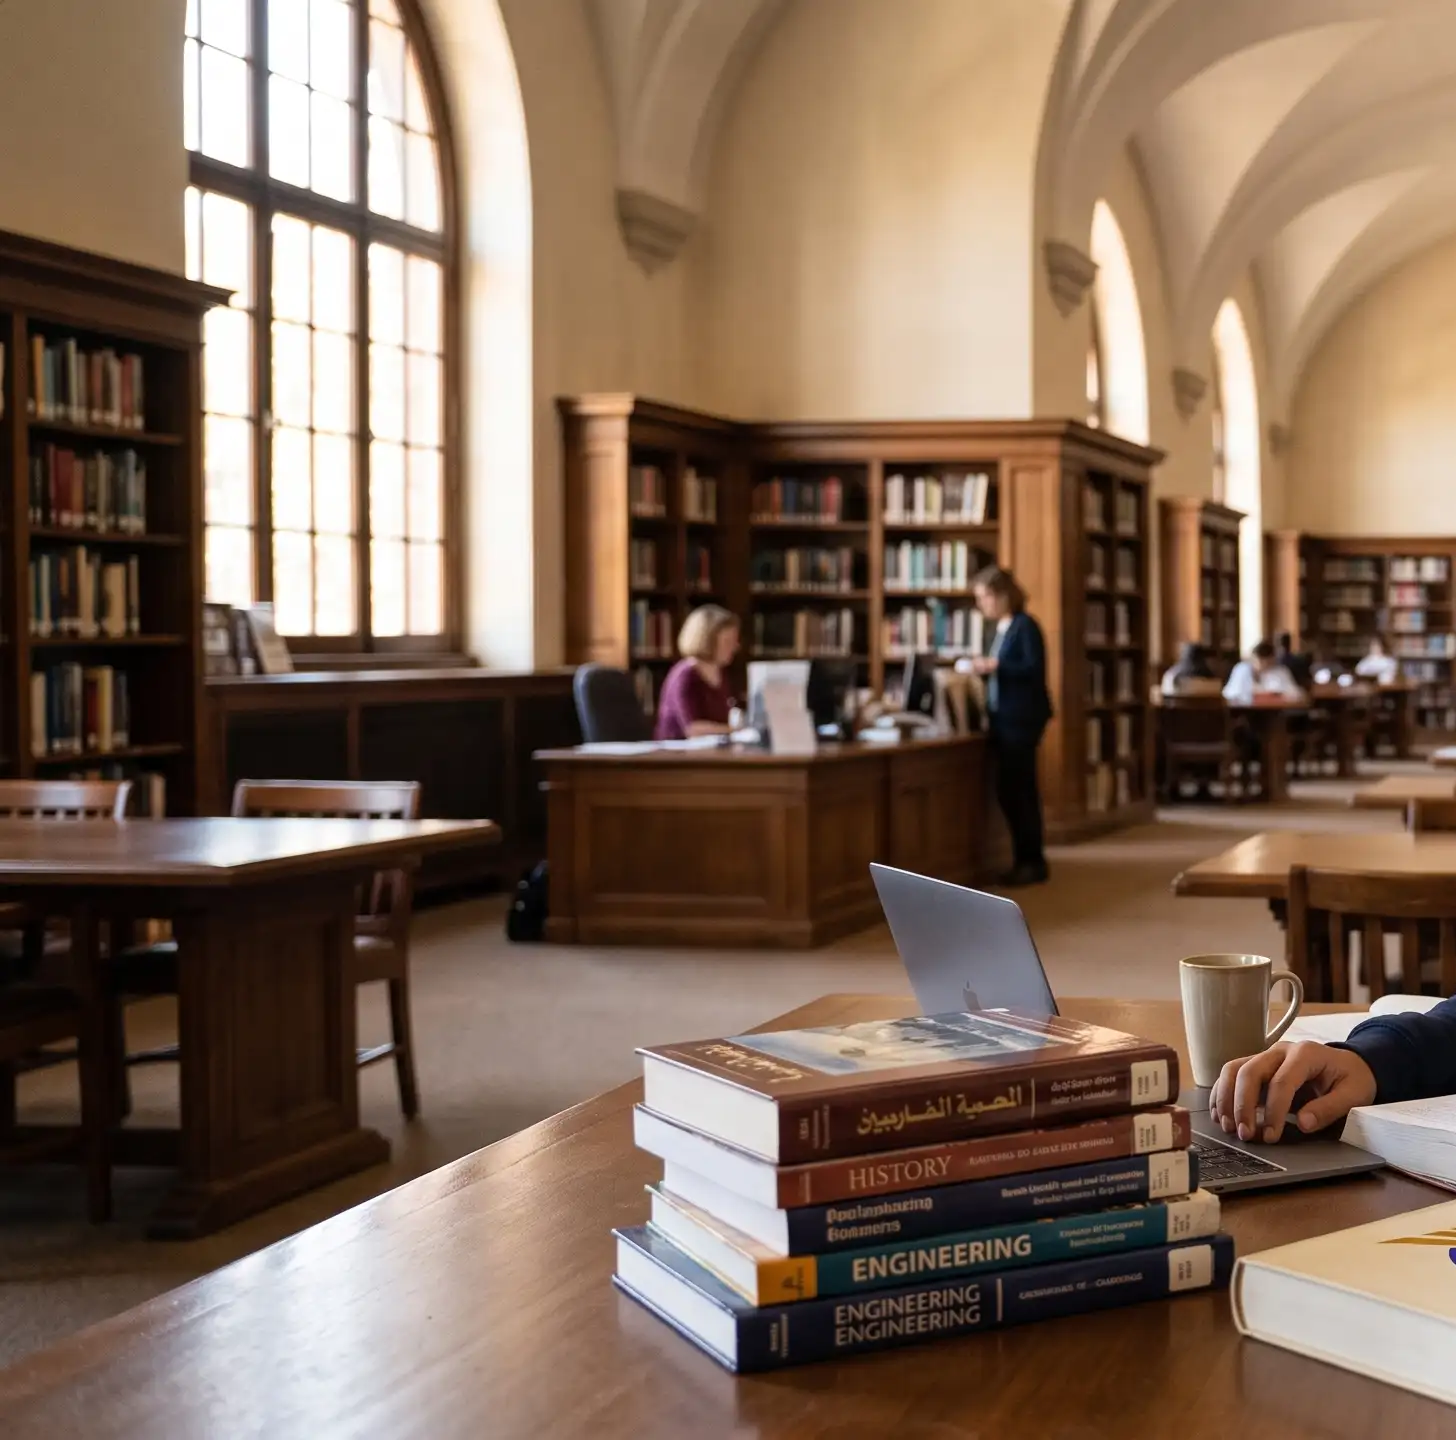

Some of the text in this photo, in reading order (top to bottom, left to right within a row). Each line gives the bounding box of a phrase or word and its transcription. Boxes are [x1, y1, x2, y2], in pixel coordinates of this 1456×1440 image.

[849, 1154, 953, 1191] HISTORY
[852, 1234, 1032, 1282] ENGINEERING
[835, 1284, 981, 1325] ENGINEERING
[835, 1305, 981, 1347] ENGINEERING
